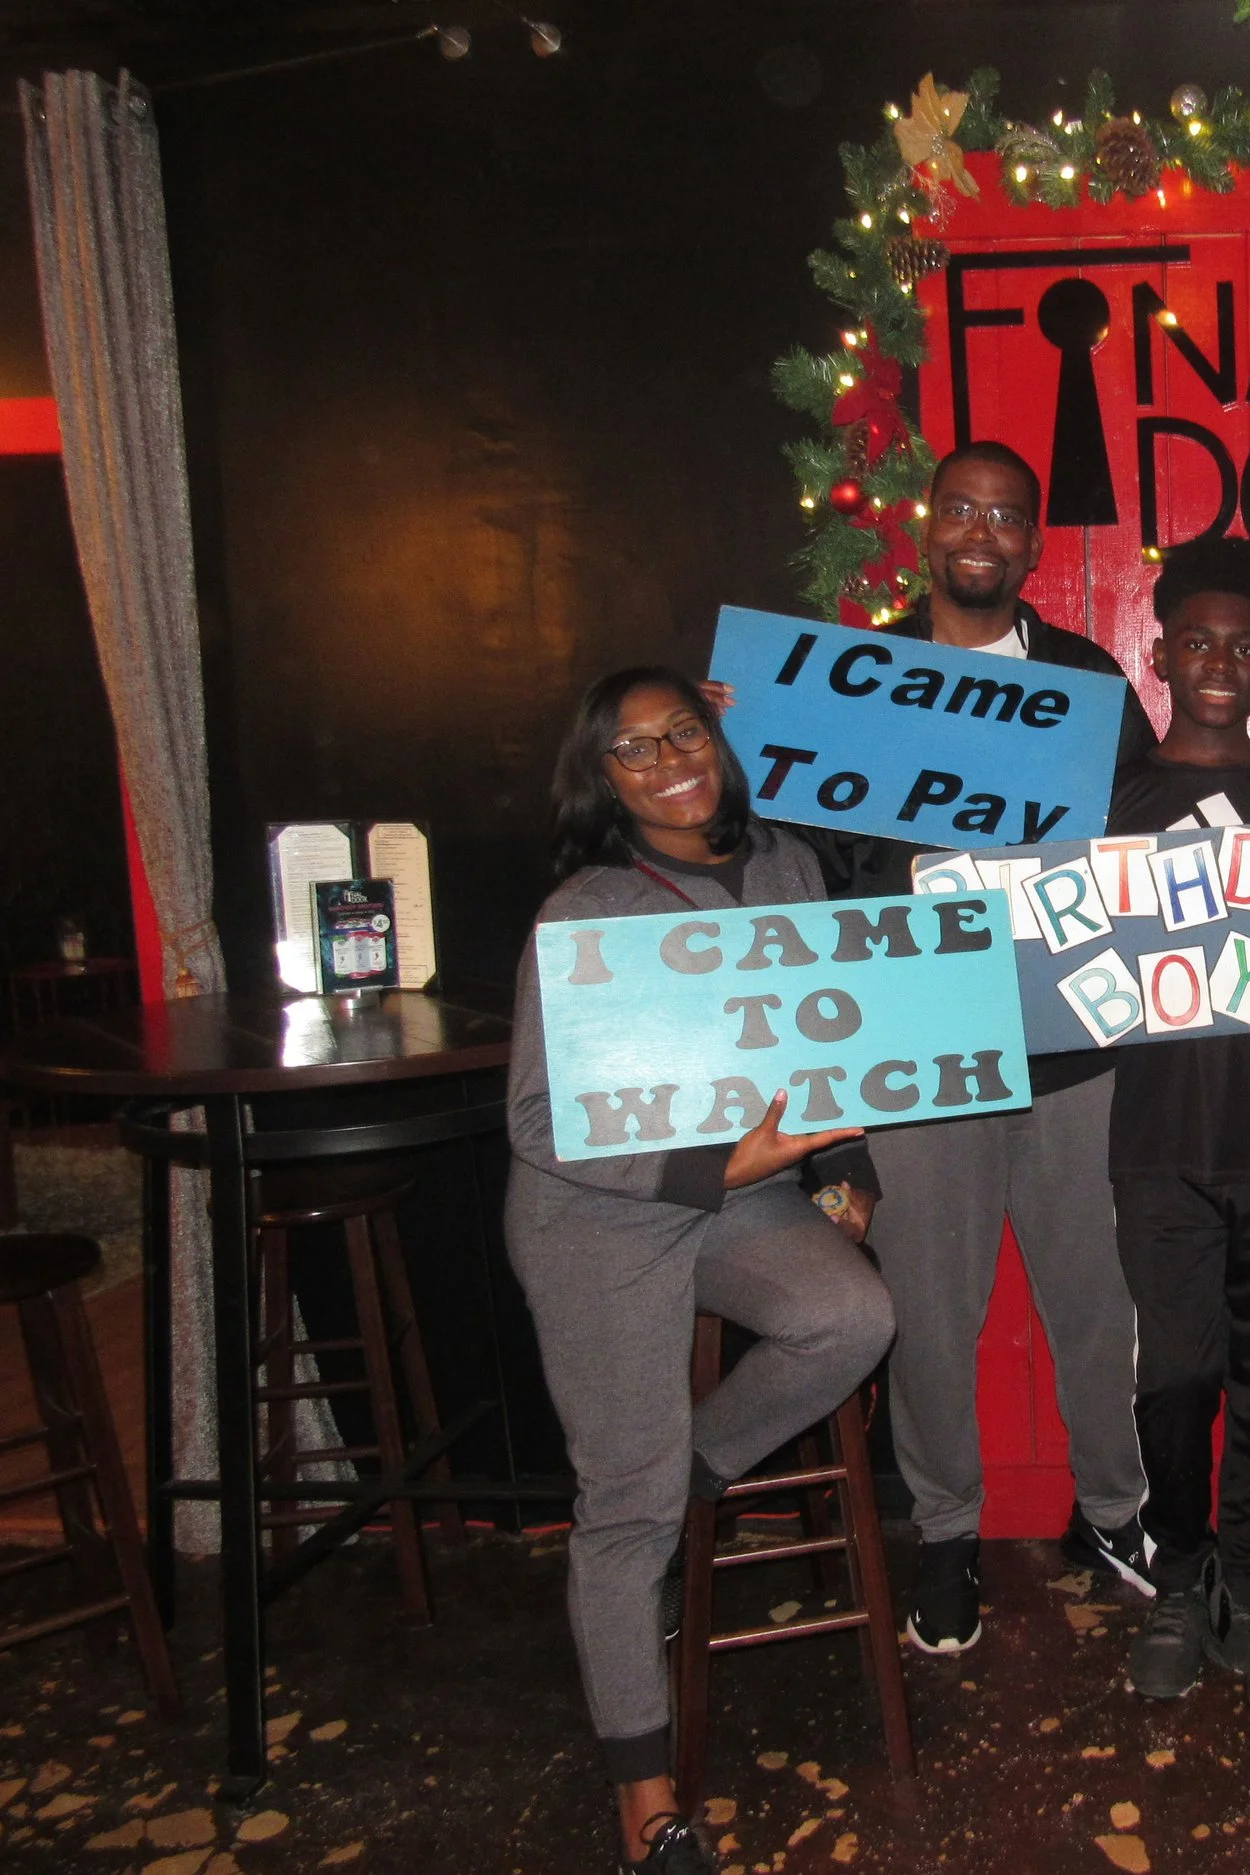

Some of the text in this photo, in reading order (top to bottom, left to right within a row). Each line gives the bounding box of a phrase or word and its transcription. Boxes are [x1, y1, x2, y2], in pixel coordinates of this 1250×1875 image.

[774, 633, 1070, 729] I Came
[756, 744, 1070, 845] To Pay
[567, 899, 992, 986] I CAME
[723, 988, 862, 1050] TO
[574, 1049, 1013, 1147] WATCH
